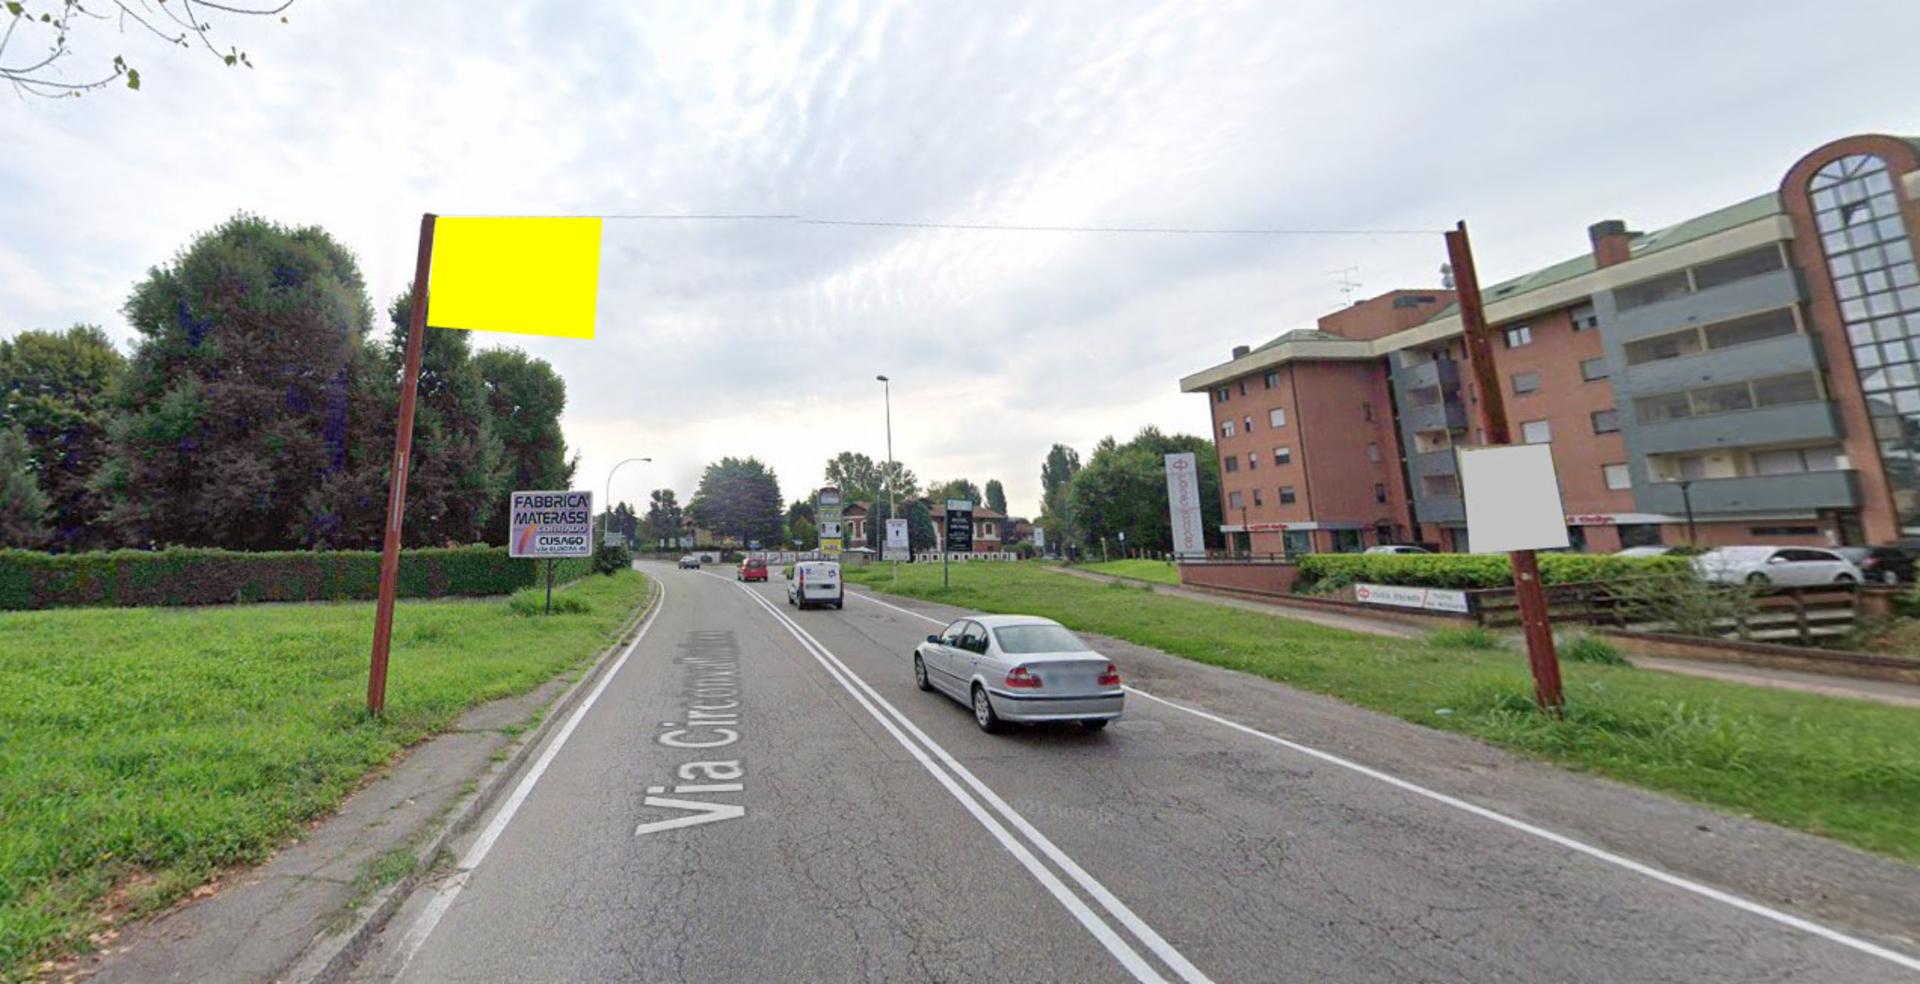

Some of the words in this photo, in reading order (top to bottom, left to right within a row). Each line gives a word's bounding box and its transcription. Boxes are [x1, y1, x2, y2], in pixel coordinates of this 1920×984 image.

[514, 496, 588, 508] FABBRICA
[514, 512, 588, 524] MATERASSI
[539, 536, 584, 545] CUSAGO
